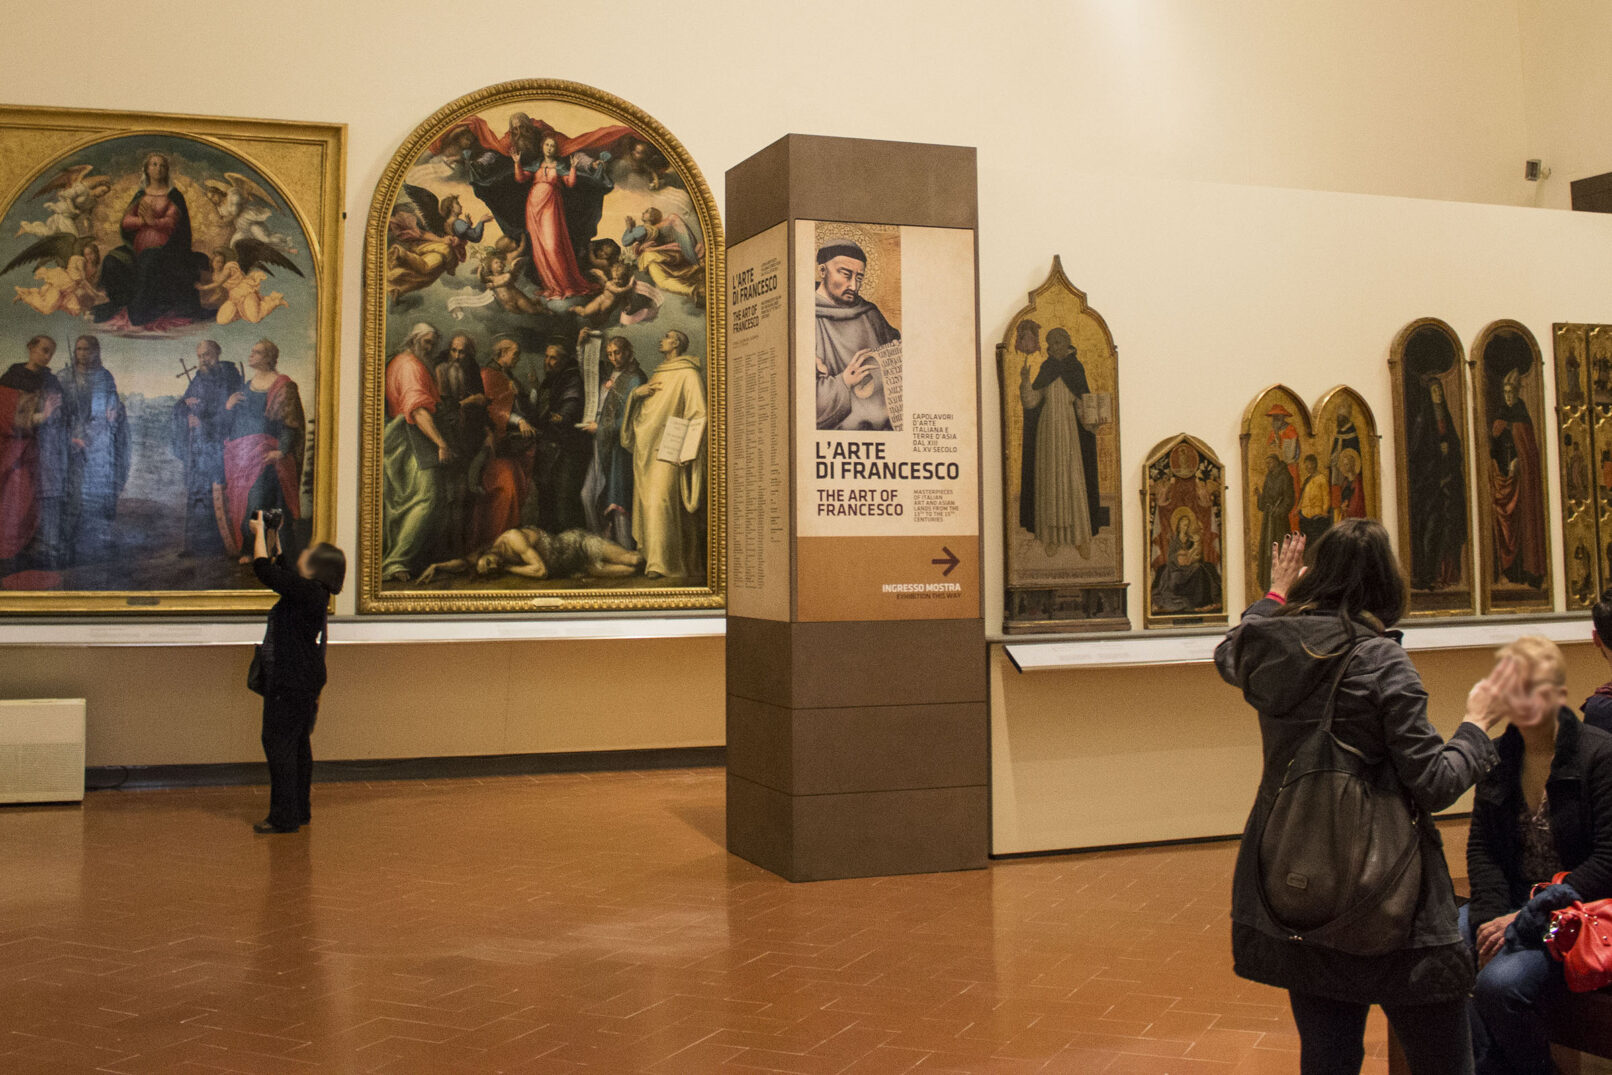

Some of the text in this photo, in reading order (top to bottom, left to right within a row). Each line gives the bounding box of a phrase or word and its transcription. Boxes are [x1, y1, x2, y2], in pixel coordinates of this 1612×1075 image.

[740, 274, 778, 303] FRANCESCO
[816, 442, 885, 459] L'ARTE
[816, 462, 959, 480] DI FRANCESCO
[817, 490, 898, 502] THE ART OF
[818, 504, 904, 516] FRANCESCO
[882, 583, 961, 592] INGRESSO MOSTRA
